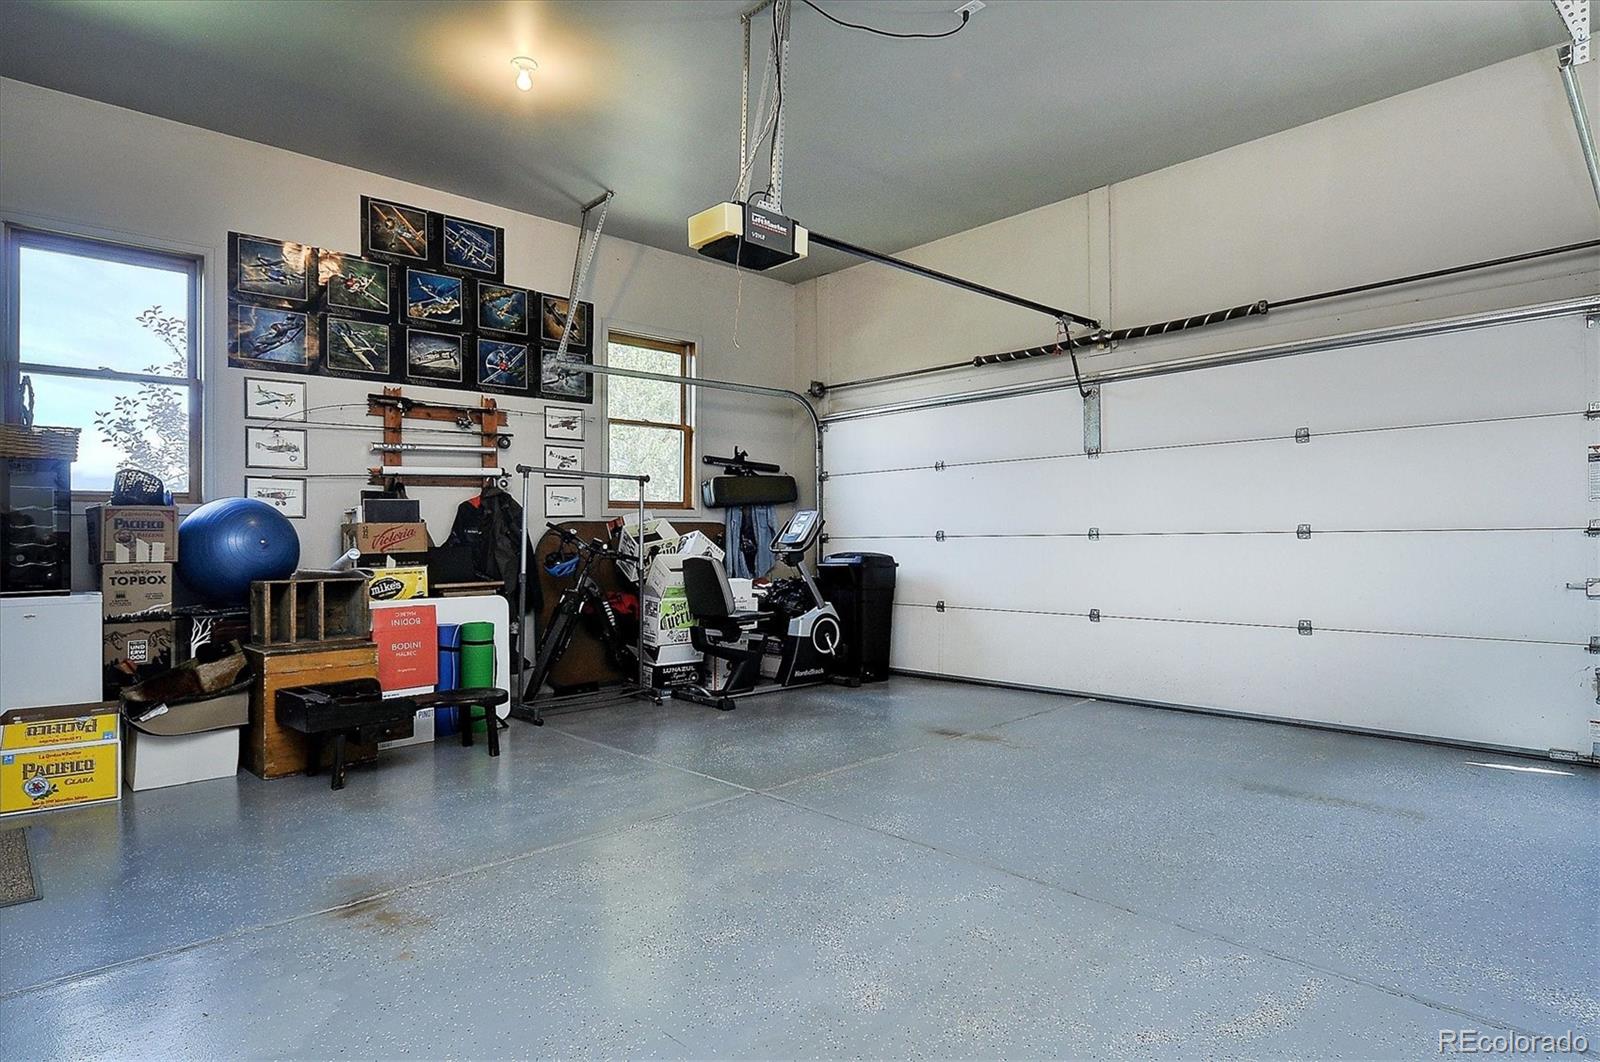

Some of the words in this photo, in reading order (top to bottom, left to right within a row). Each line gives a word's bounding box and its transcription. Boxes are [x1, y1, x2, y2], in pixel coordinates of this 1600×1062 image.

[751, 213, 788, 232] LiftMaster
[372, 526, 416, 551] Victoria
[109, 575, 167, 586] TOPBOX
[371, 581, 402, 596] mike's
[391, 617, 421, 626] BODINI
[391, 642, 421, 651] BODINI
[662, 666, 696, 674] LUNAZUL
[23, 760, 96, 780] PACIFICO
[64, 777, 94, 786] CLARA
